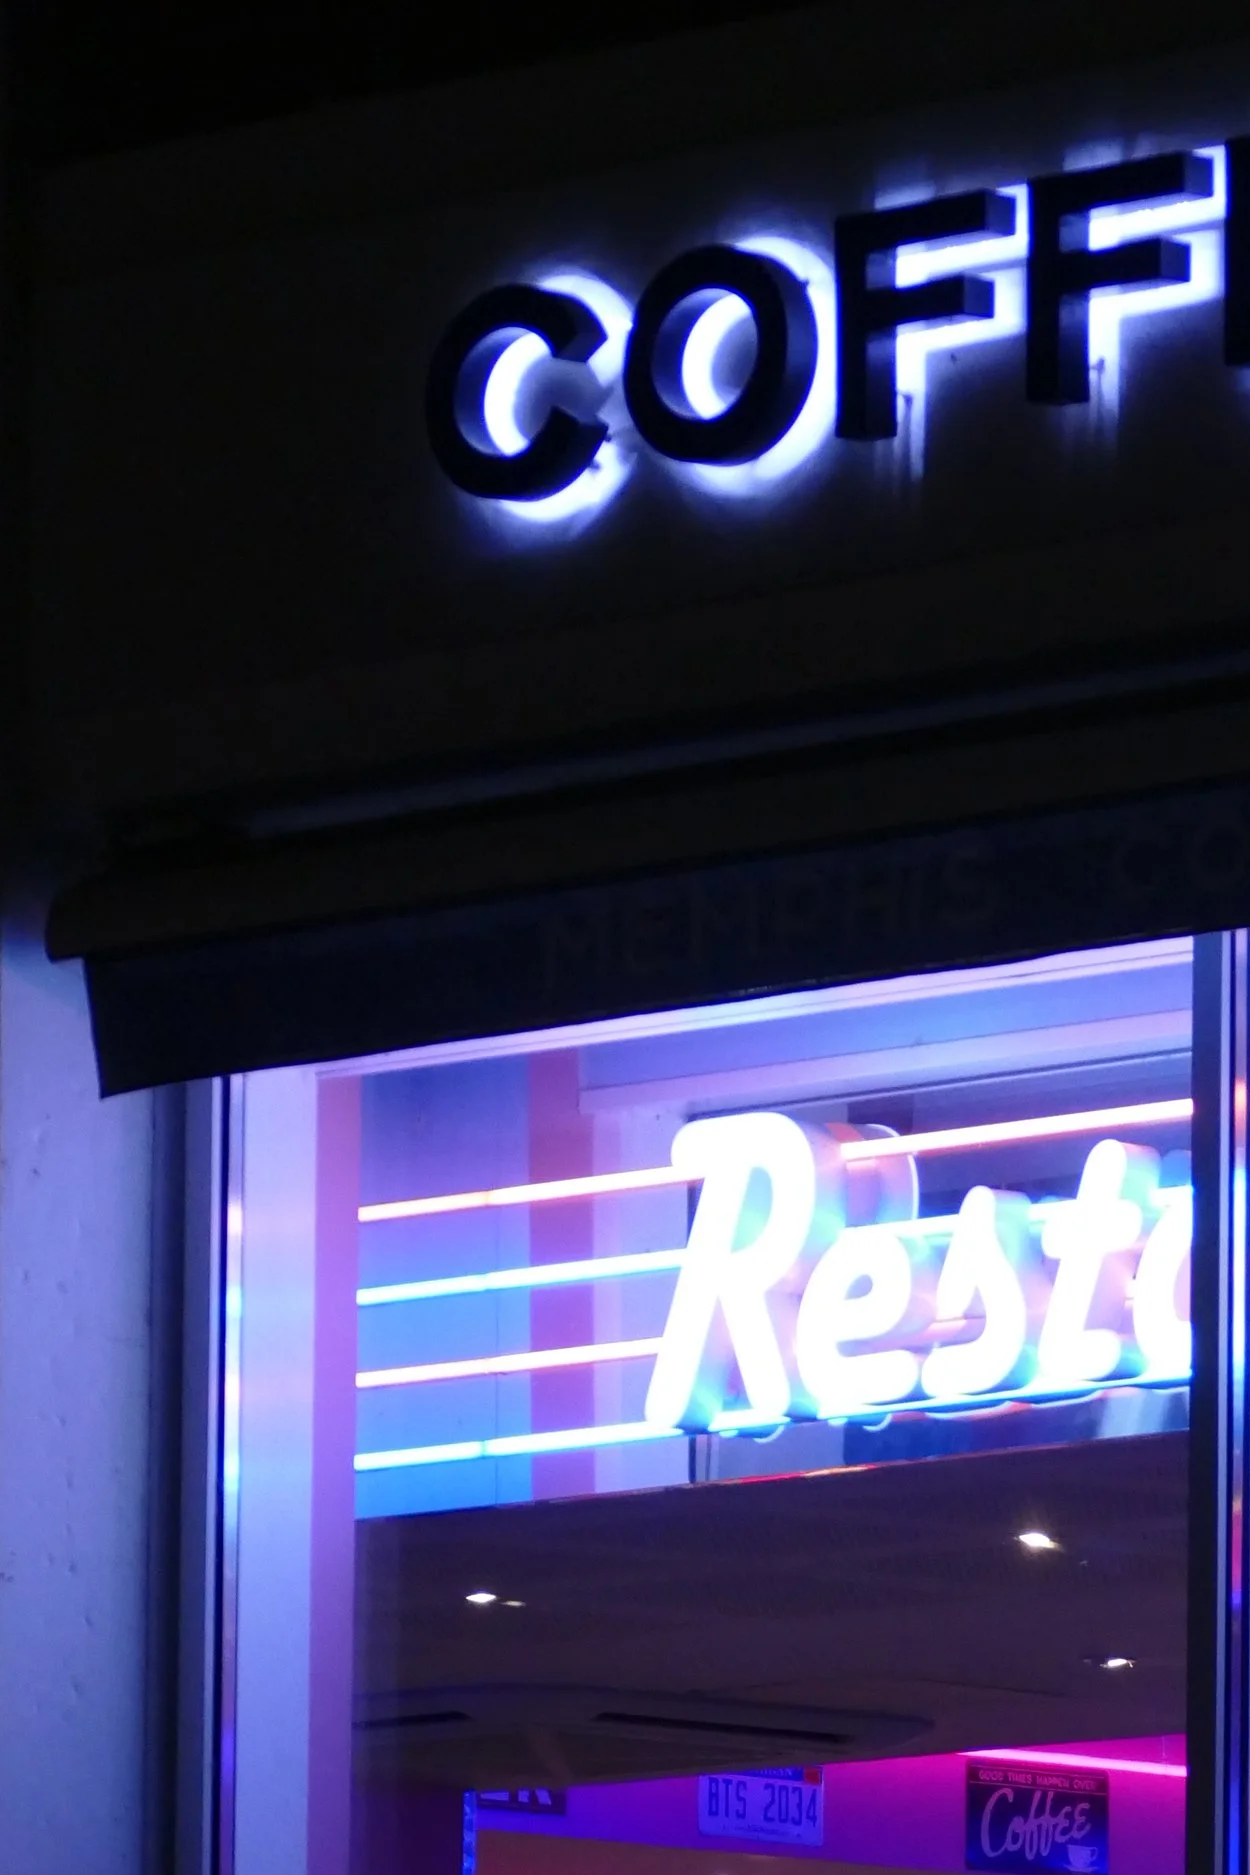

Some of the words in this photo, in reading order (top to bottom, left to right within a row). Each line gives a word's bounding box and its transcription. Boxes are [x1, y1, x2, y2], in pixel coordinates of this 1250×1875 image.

[542, 842, 996, 994] MEMPHIS
[708, 1776, 747, 1820] BTS
[763, 1783, 817, 1827] 2034
